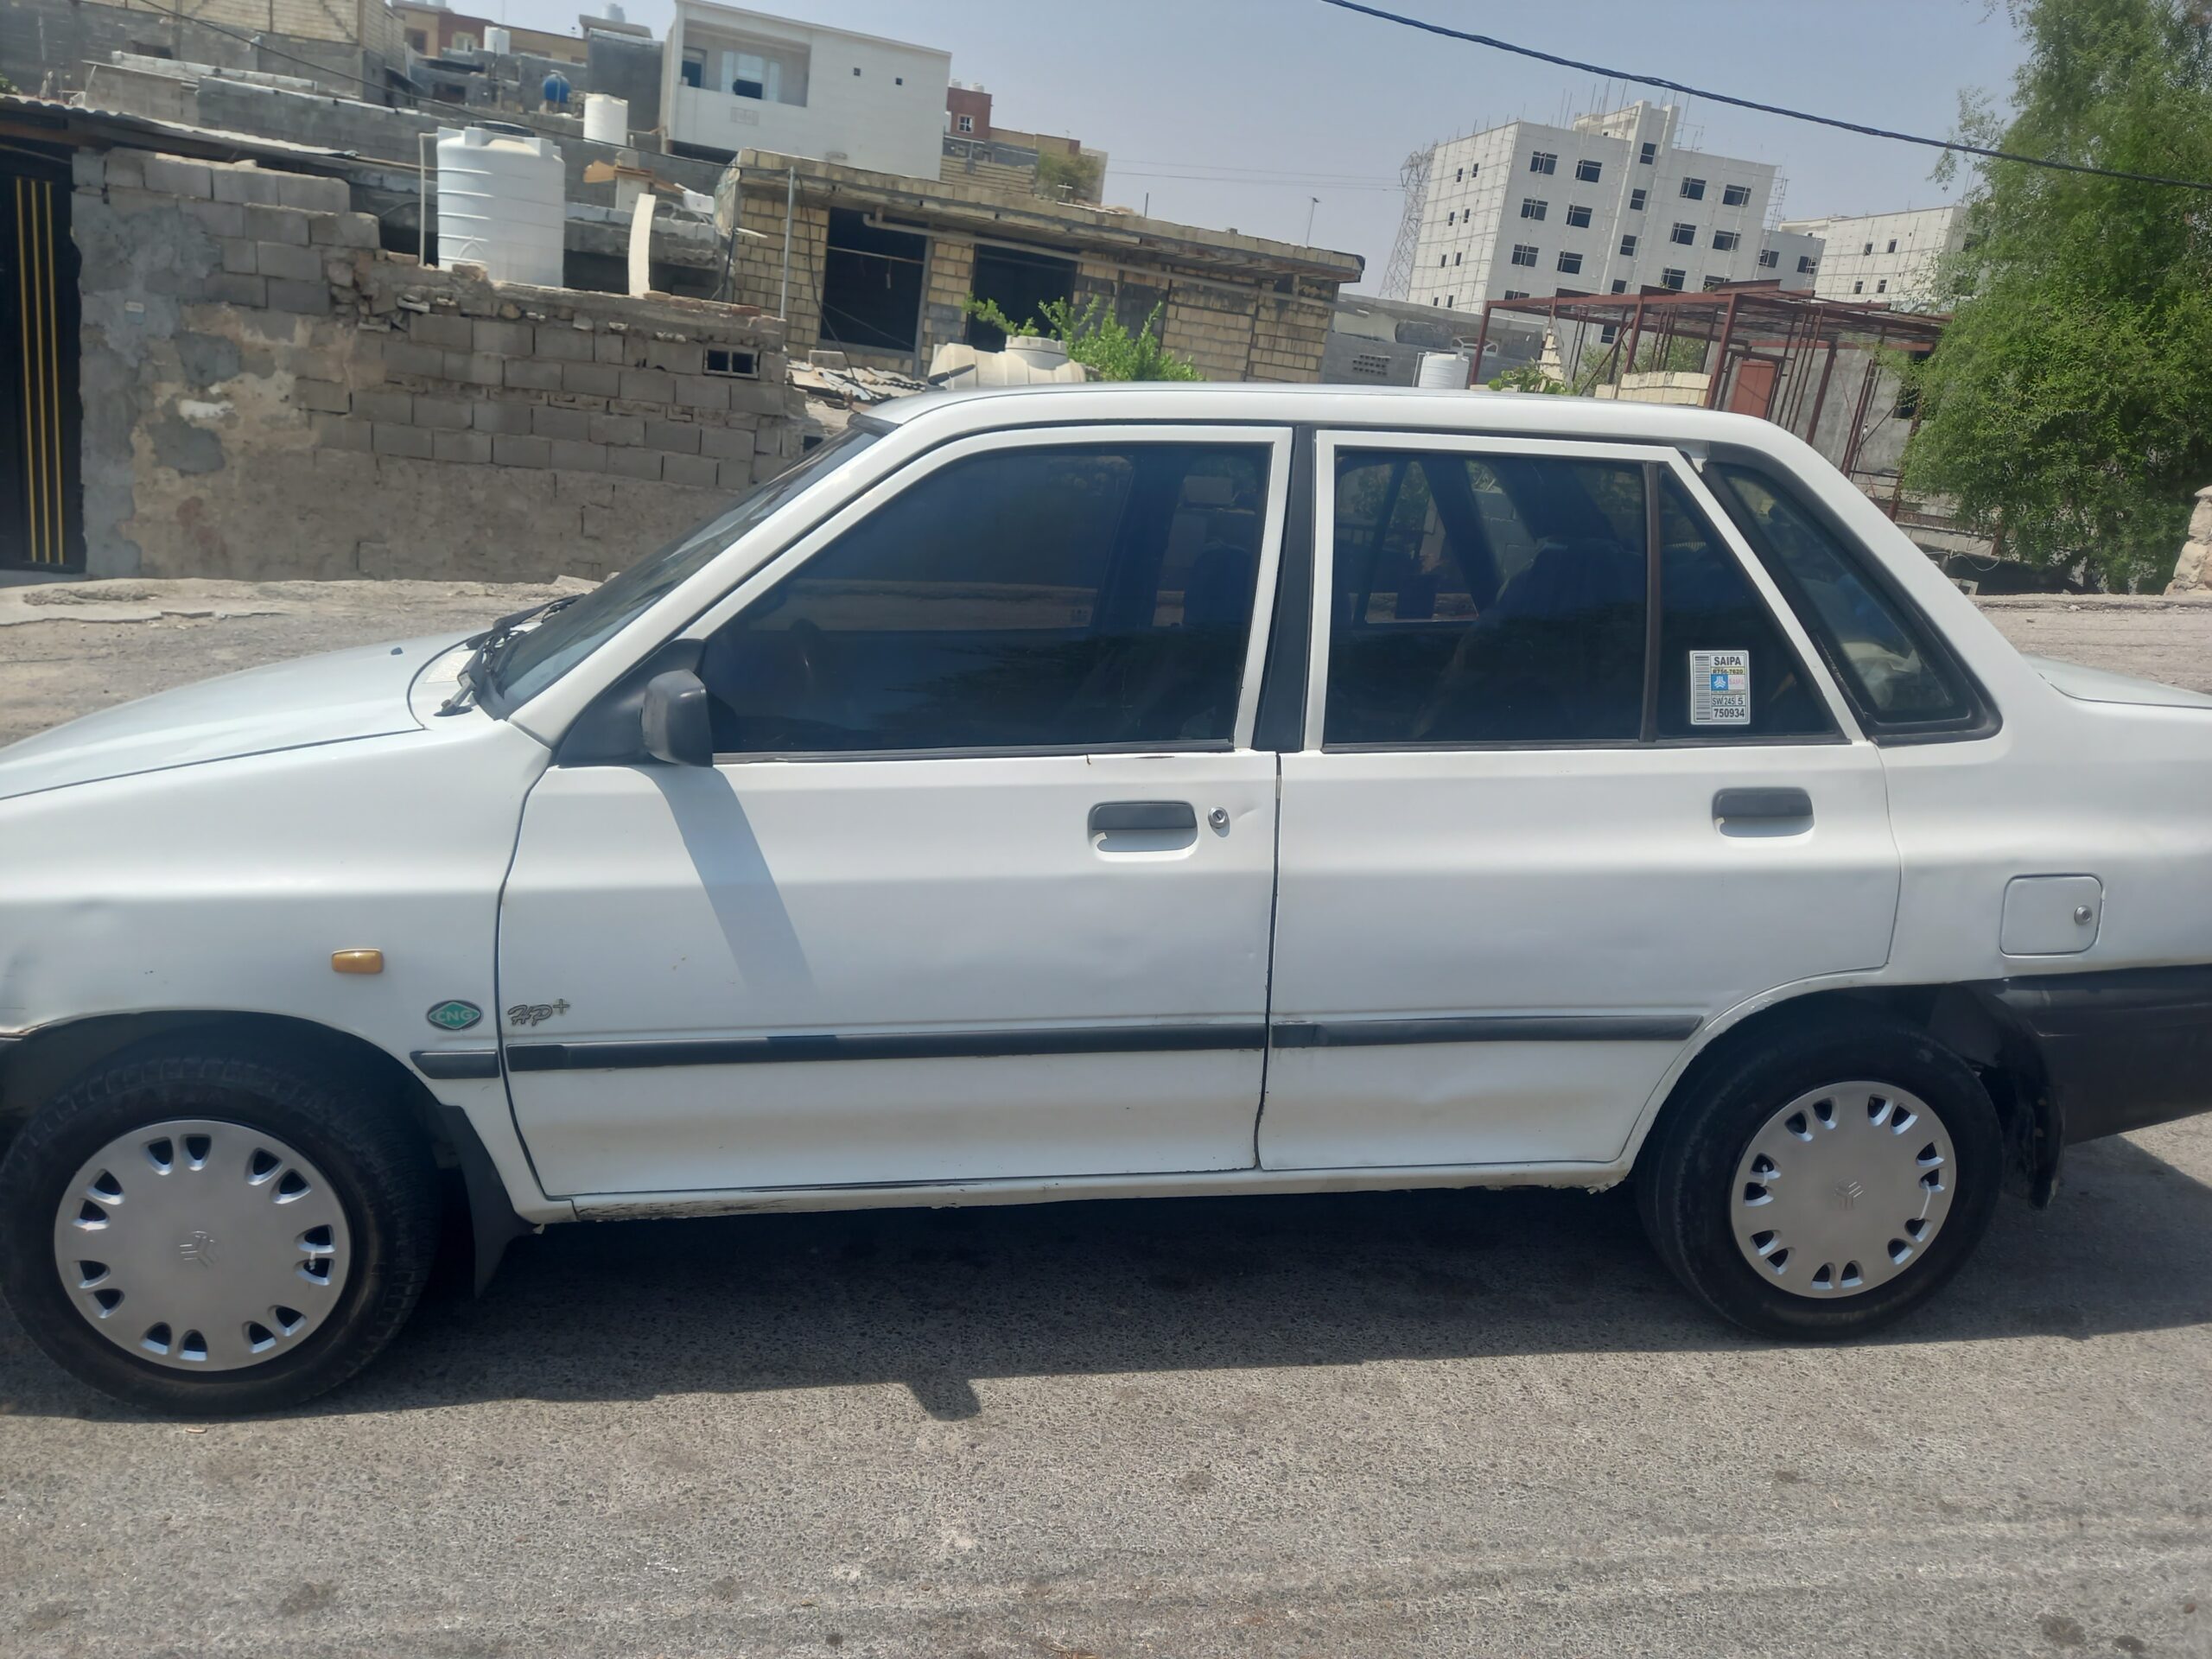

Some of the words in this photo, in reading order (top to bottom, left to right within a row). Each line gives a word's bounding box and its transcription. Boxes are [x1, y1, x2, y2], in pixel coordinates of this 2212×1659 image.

[1714, 657, 1741, 665] SAIPA
[1713, 708, 1745, 717] 750934
[435, 1010, 474, 1022] CNG
